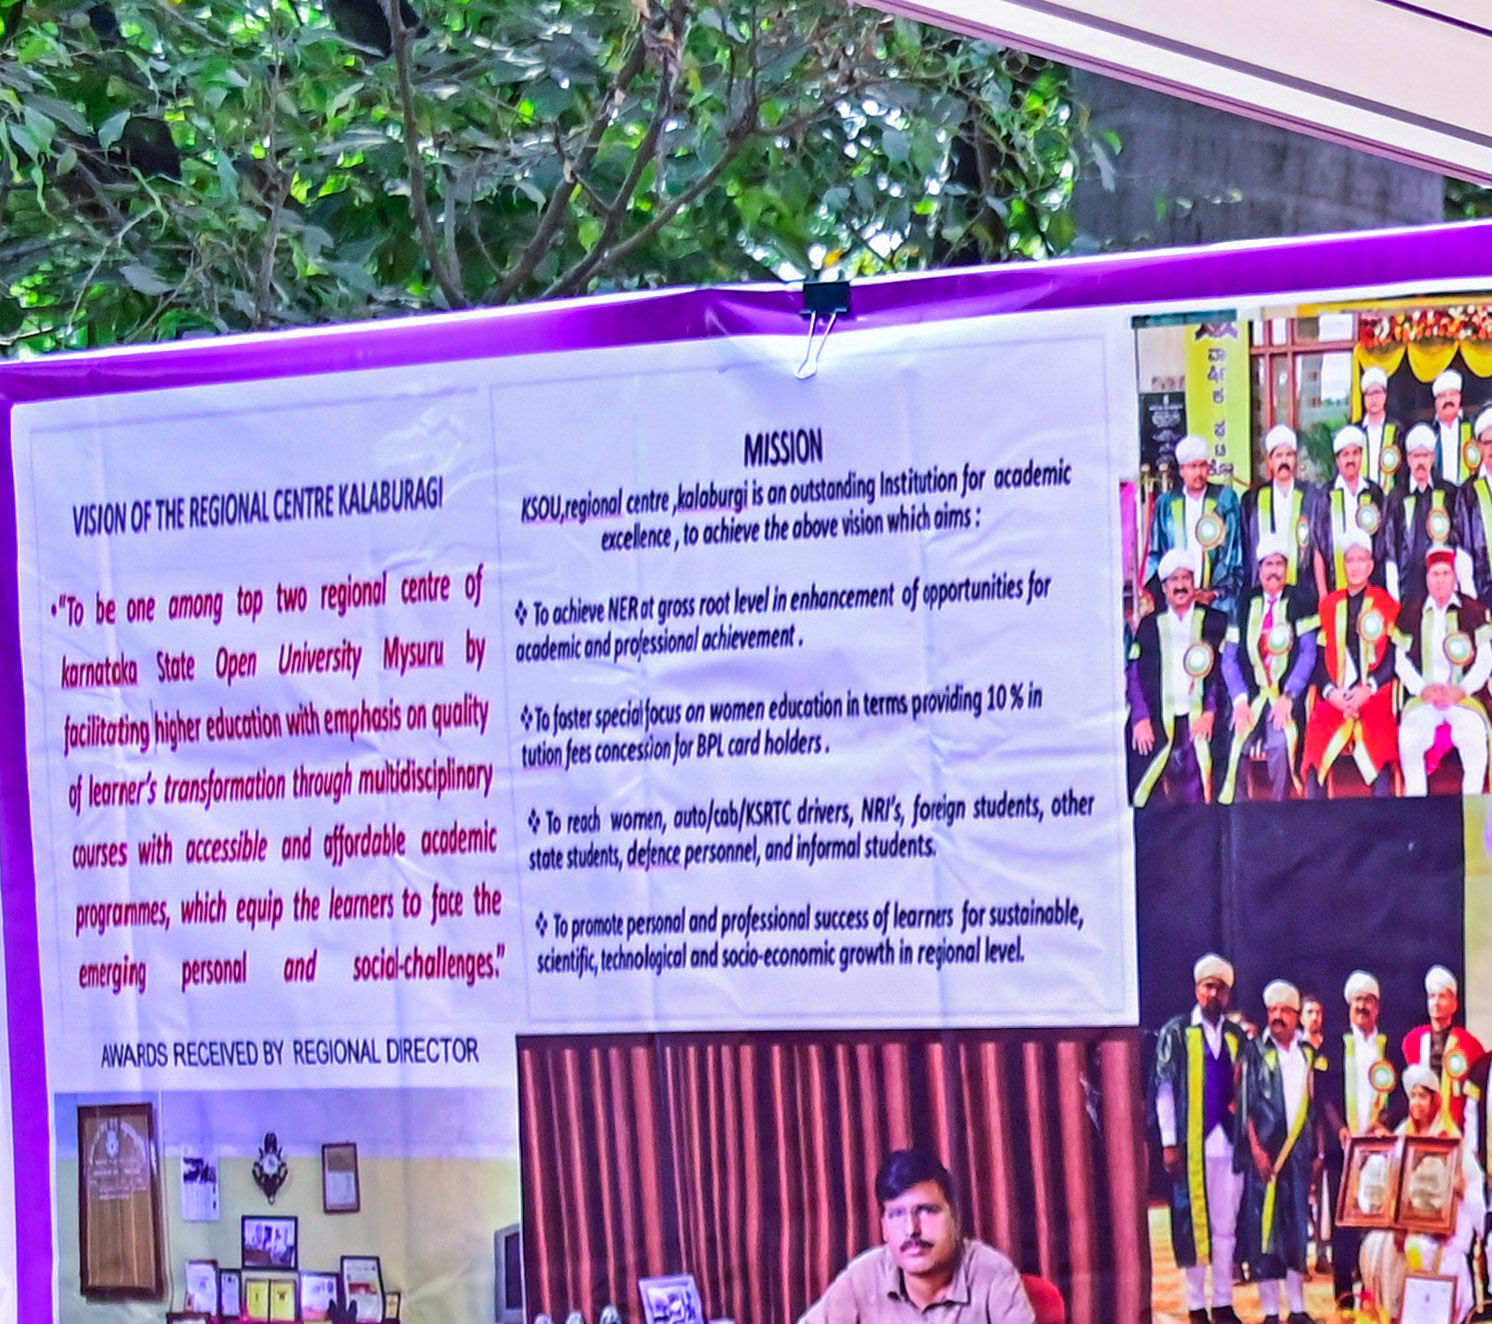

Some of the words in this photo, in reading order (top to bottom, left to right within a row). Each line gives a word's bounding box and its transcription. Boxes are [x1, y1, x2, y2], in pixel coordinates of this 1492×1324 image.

[743, 427, 824, 468] MISSION
[72, 501, 127, 537] VISION
[130, 499, 153, 534] OF
[155, 497, 185, 531] THE
[189, 490, 270, 529] REGIONAL
[273, 484, 335, 523] CENTRE
[338, 475, 444, 516] KALABURAGI
[520, 487, 623, 525] KSOU,regional
[626, 489, 670, 515] centre
[751, 478, 764, 507] is
[767, 484, 787, 506] an
[789, 470, 876, 505] outstanding
[879, 465, 958, 497] Institution
[960, 462, 987, 499] for
[993, 457, 1072, 490] academic
[95, 591, 116, 626] be
[126, 596, 156, 624] one
[168, 592, 224, 626] among
[237, 585, 264, 623] top
[276, 582, 308, 614] two
[320, 570, 387, 618] regional
[400, 570, 451, 605] centre
[464, 562, 484, 608] of
[60, 652, 138, 690] karnataka
[156, 650, 196, 683] State
[215, 646, 257, 687] Open
[278, 638, 363, 680] University
[383, 636, 444, 677] Mysuru
[465, 628, 486, 672] by
[63, 713, 151, 758] facilitating
[154, 709, 202, 753] higher
[206, 705, 283, 742] education
[285, 701, 321, 737] with
[323, 697, 402, 744] emphasis
[406, 703, 427, 731] on
[431, 692, 489, 738] quality
[68, 773, 83, 817] of
[163, 766, 286, 811] transformation
[292, 761, 353, 805] through
[358, 756, 494, 801] multidisciplinary
[72, 842, 128, 870] courses
[138, 832, 173, 866] with
[185, 828, 268, 864] accessible
[281, 826, 312, 861] and
[323, 822, 406, 867] affordable
[420, 819, 498, 856] academic
[75, 900, 171, 938] programmes,
[180, 889, 227, 925] which
[236, 888, 284, 931] equip
[293, 887, 321, 922] the
[328, 886, 394, 921] learners
[401, 887, 422, 919] to
[430, 881, 464, 926] face
[473, 881, 502, 917] the
[78, 954, 147, 996] emerging
[181, 950, 247, 994] personal
[283, 948, 318, 983] and
[100, 1041, 169, 1069] AWARDS
[173, 1039, 259, 1067] RECEIVED
[262, 1039, 284, 1066] BY
[292, 1038, 382, 1066] REGIONAL
[386, 1036, 480, 1064] DIRECTOR
